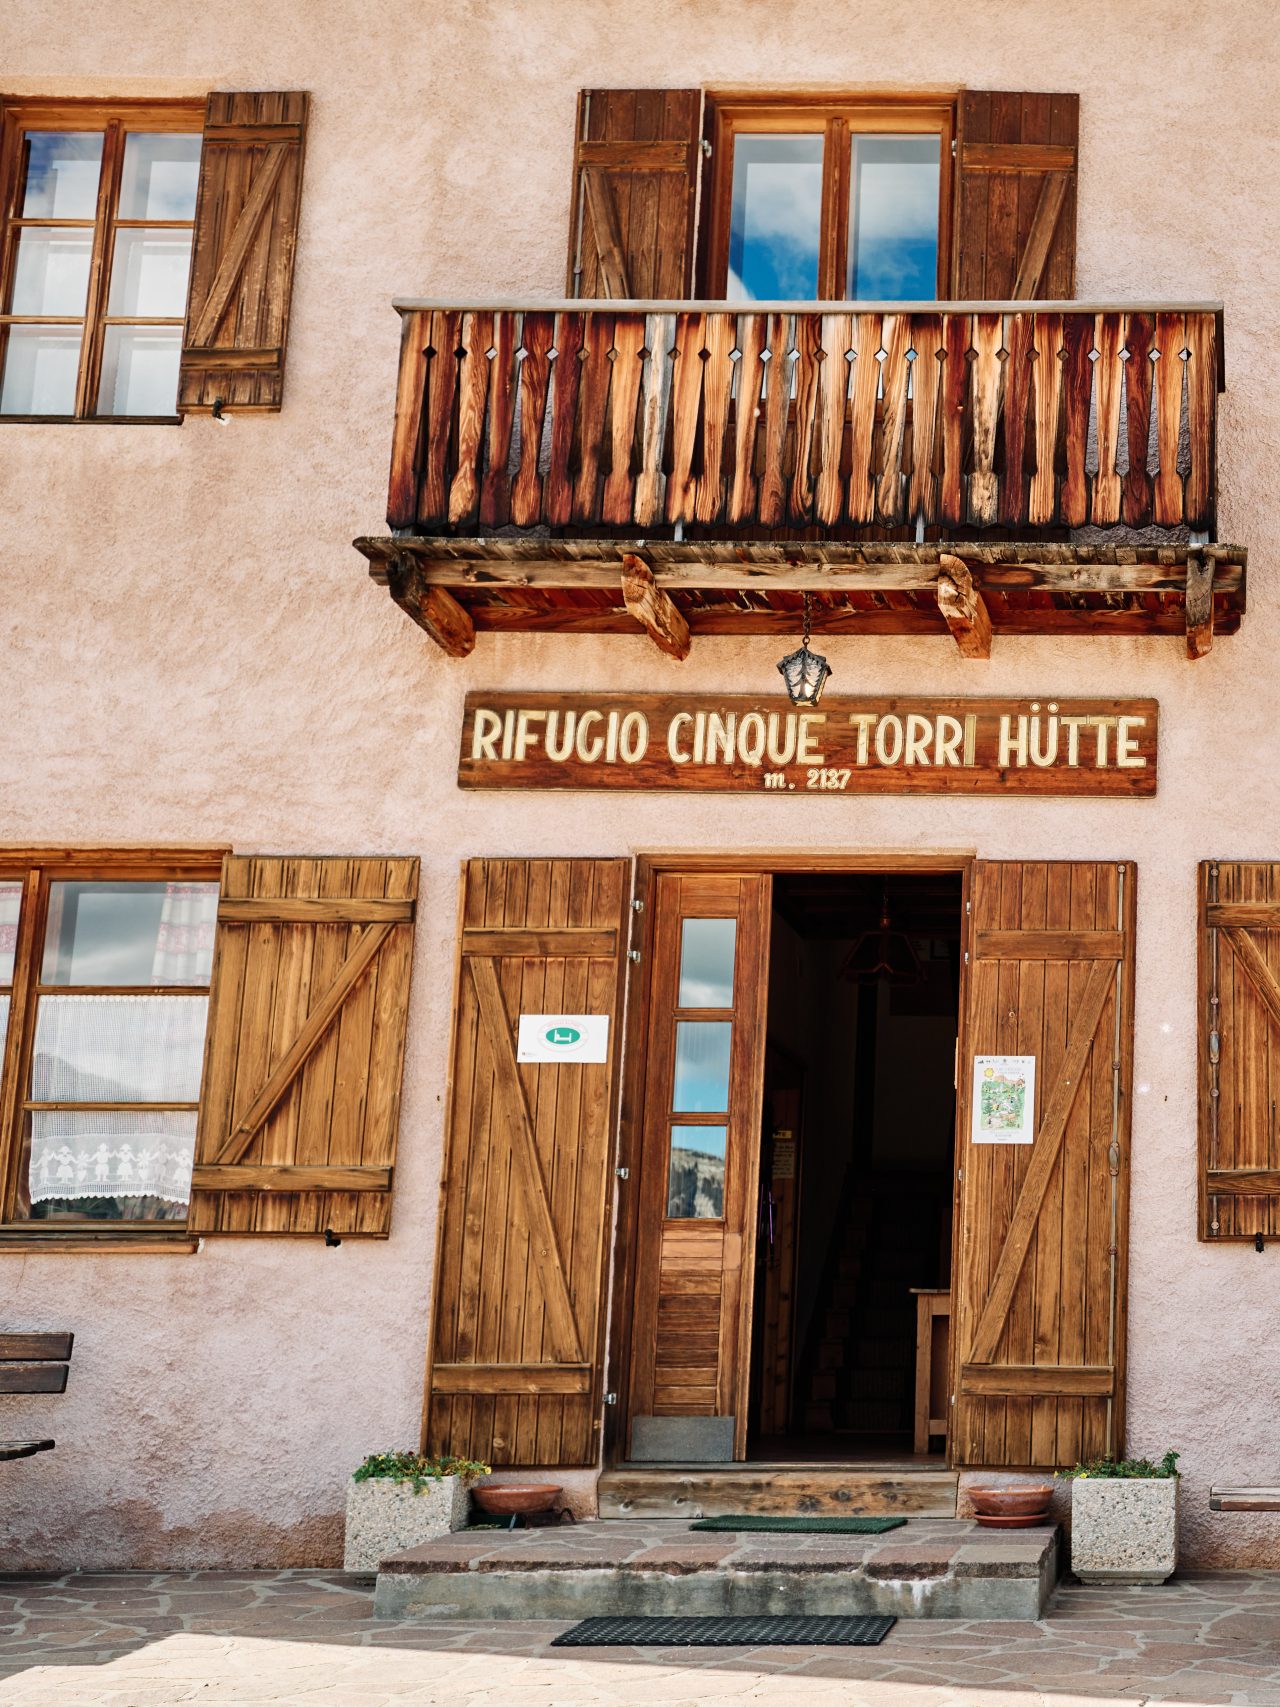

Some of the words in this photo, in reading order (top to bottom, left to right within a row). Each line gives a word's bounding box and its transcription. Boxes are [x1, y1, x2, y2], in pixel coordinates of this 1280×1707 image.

[471, 708, 649, 765] RIFUGIO
[667, 710, 828, 767] CINQUE
[848, 713, 977, 767] TORRI
[997, 702, 1147, 769] HÜTTE
[763, 771, 796, 790] m.
[806, 767, 852, 790] 2137
